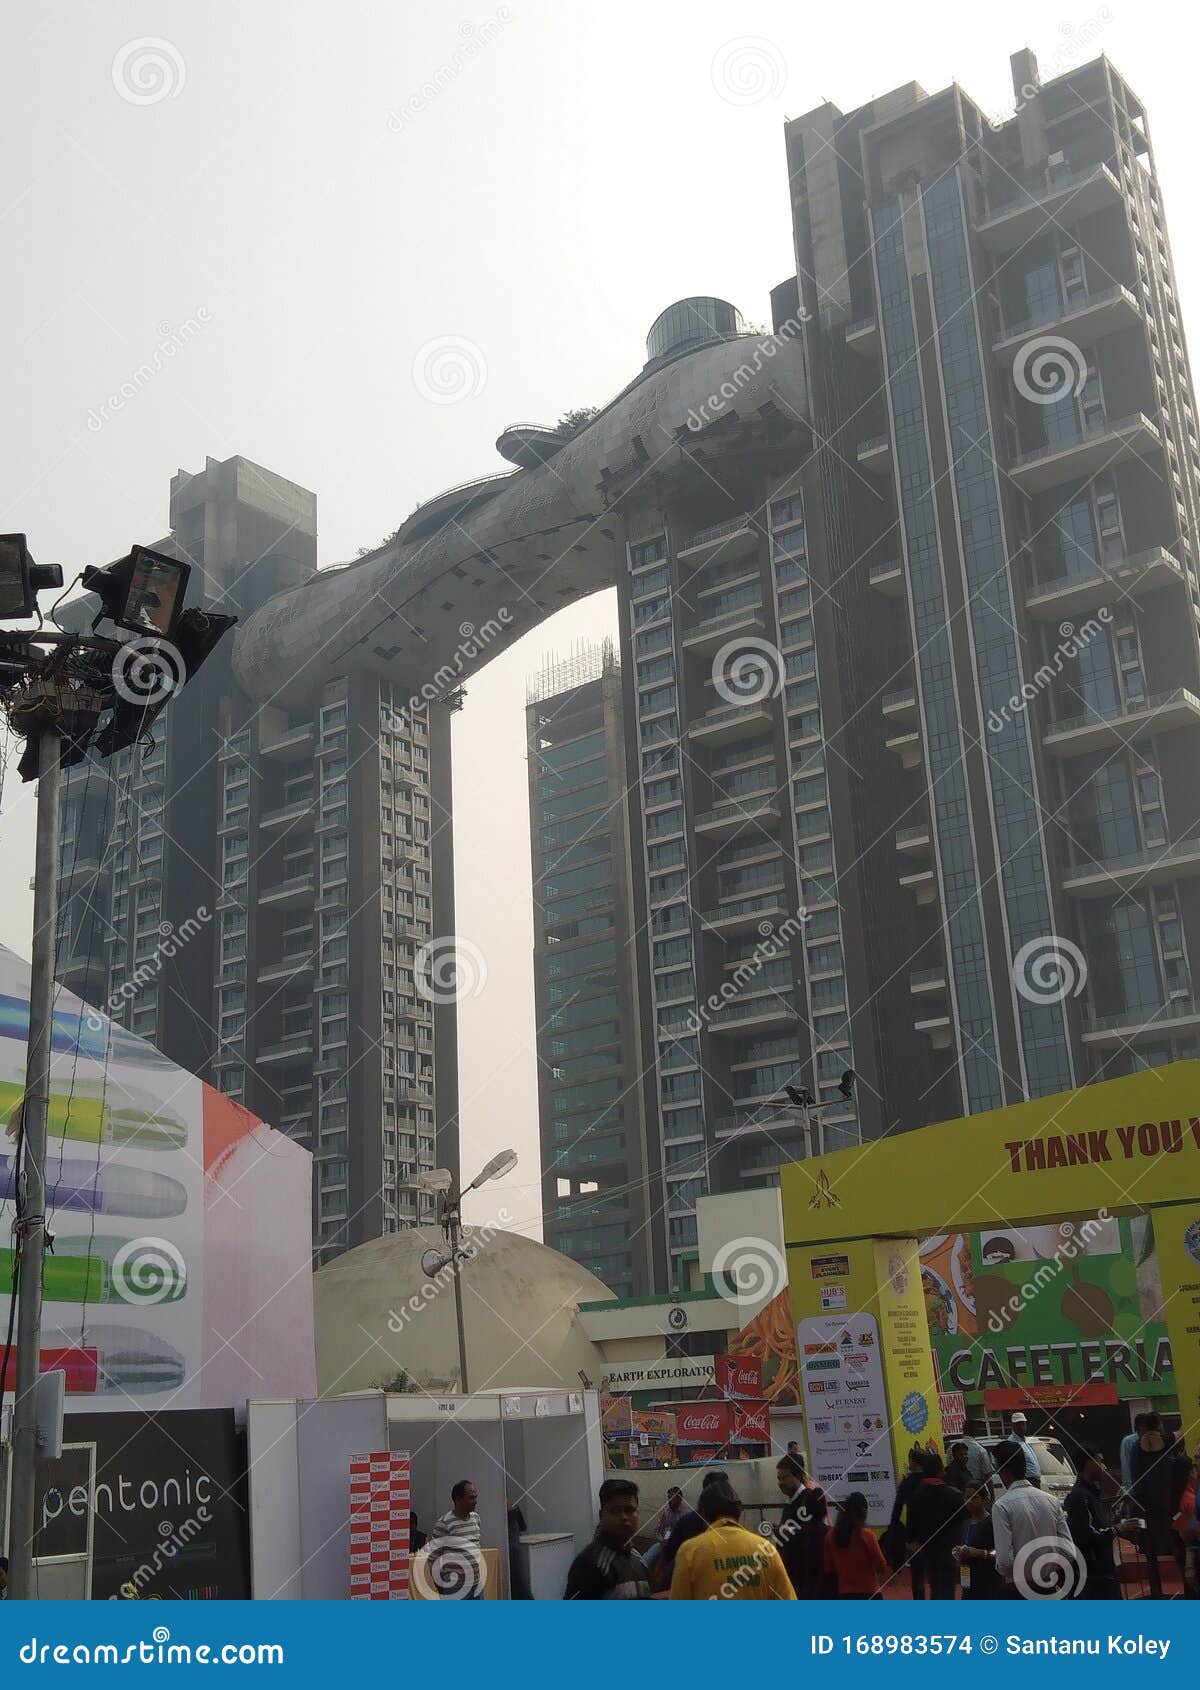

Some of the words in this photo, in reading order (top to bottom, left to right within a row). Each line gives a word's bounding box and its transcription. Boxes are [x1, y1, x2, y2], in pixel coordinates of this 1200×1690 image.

[1005, 1129, 1112, 1173] THANK
[1116, 1119, 1184, 1160] YOU
[609, 1370, 643, 1383] EARTH
[647, 1365, 714, 1380] EXPLORATIO
[950, 1337, 1174, 1391] CAFETERIA
[43, 1469, 210, 1528] pentonic
